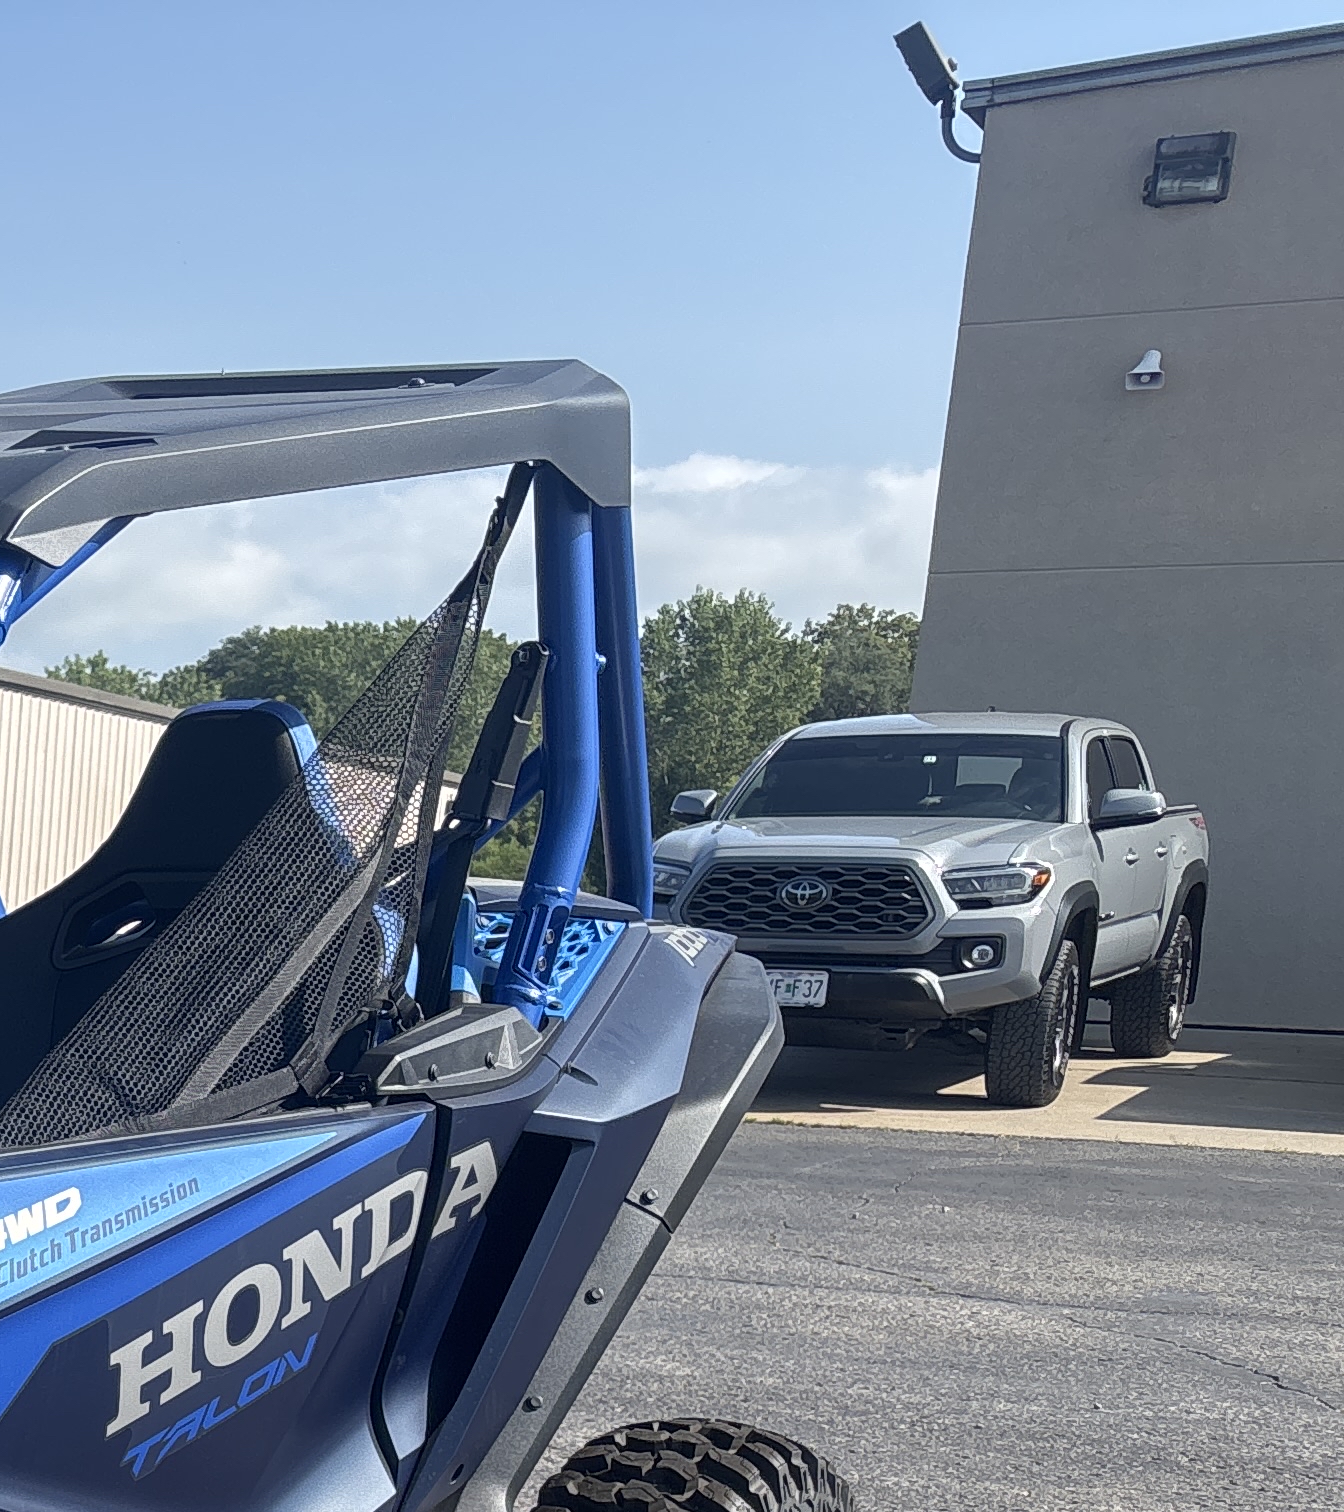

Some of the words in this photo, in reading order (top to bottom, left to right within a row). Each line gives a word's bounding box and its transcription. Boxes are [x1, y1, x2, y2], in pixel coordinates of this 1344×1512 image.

[65, 1177, 201, 1253] Transmission
[105, 1139, 500, 1440] HONDA
[121, 1332, 318, 1481] TALON
